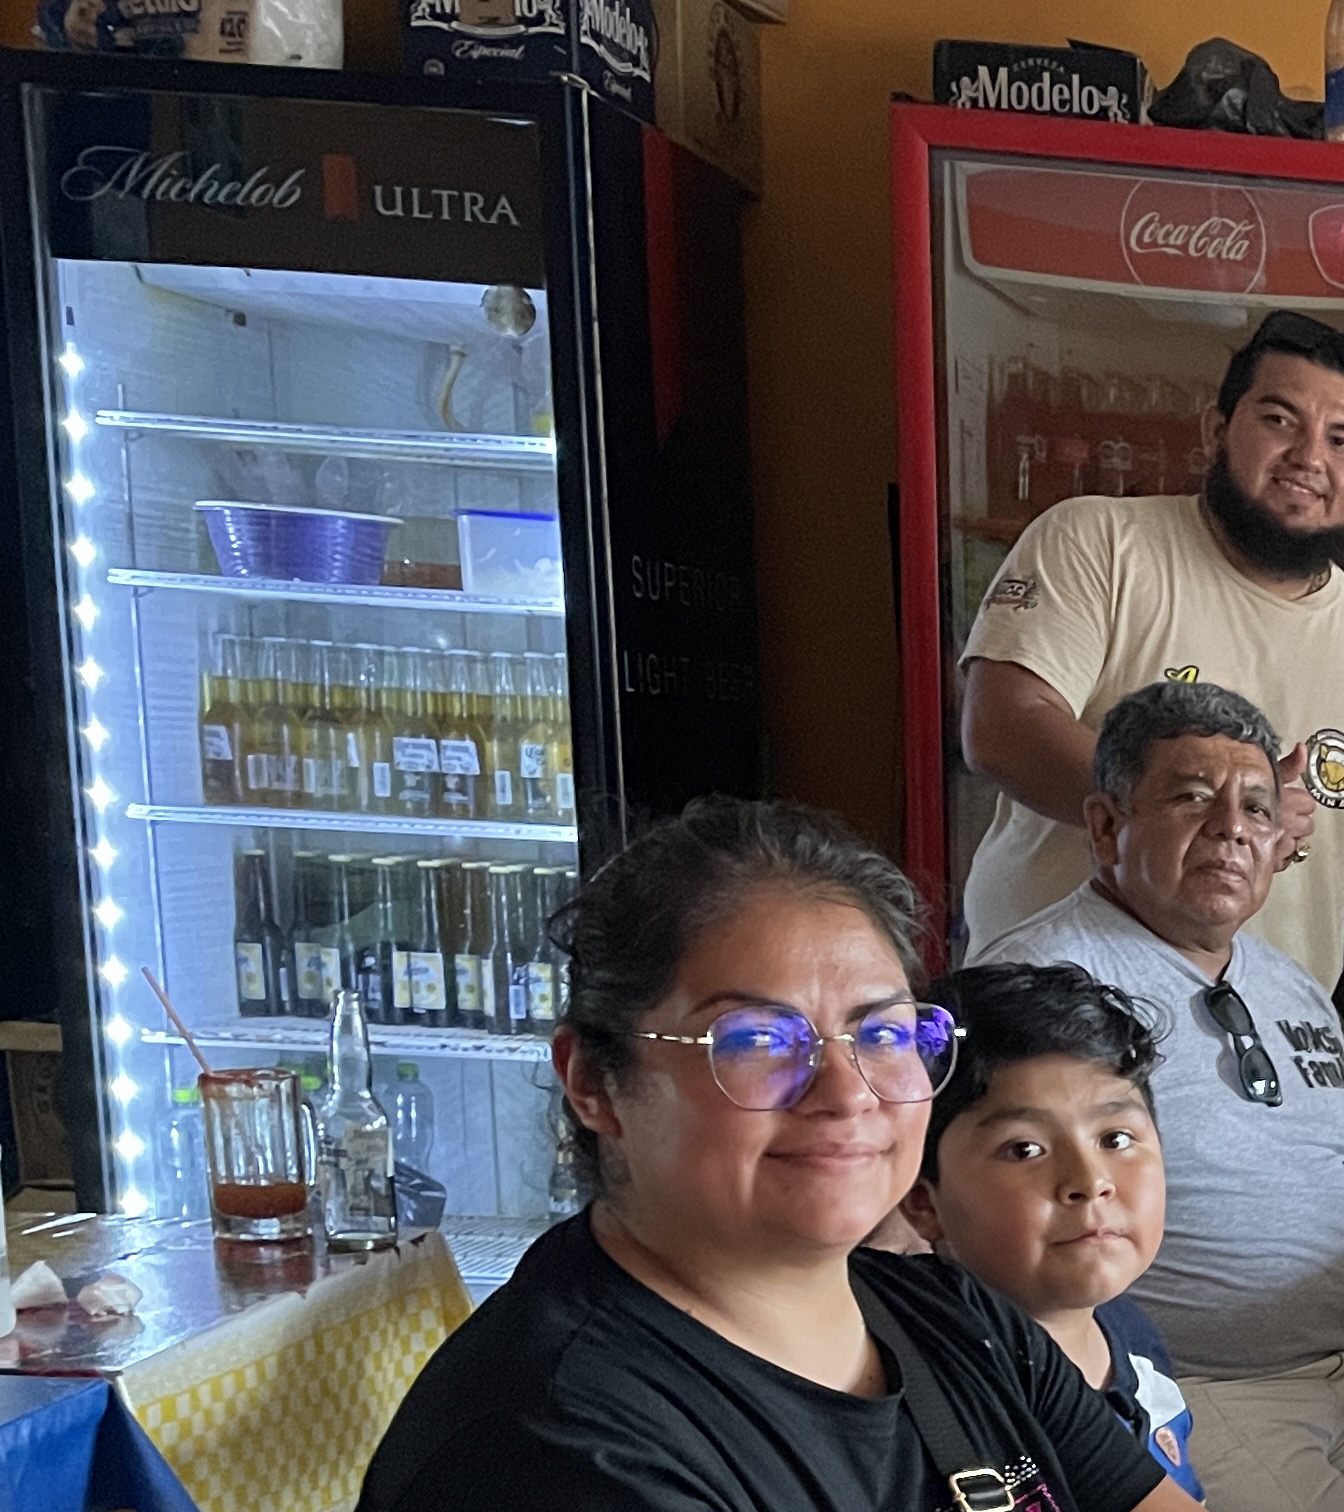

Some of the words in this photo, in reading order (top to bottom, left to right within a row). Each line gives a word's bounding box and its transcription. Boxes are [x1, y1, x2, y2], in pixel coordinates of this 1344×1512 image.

[977, 65, 1101, 116] Modelo
[1013, 57, 1066, 74] CERVEZA
[60, 145, 307, 209] Michelob
[373, 184, 522, 228] ULTRA
[1130, 211, 1255, 262] Coca-Cola
[623, 650, 690, 695] LIGHT
